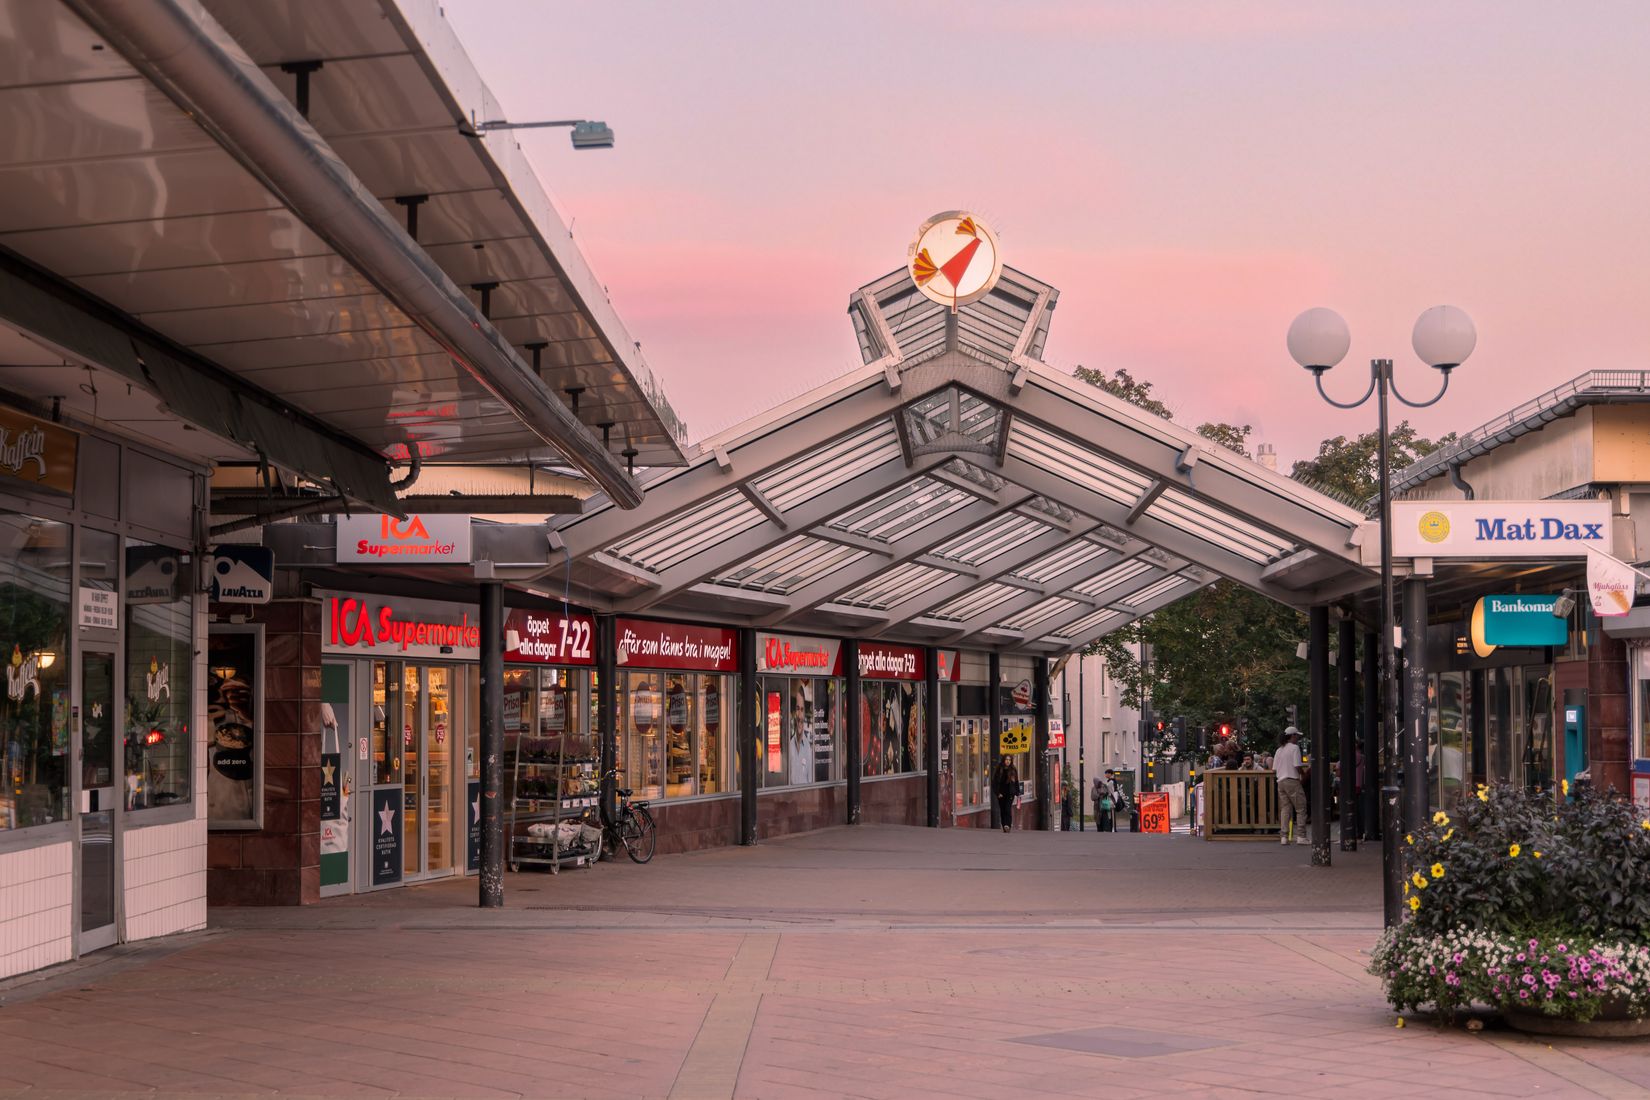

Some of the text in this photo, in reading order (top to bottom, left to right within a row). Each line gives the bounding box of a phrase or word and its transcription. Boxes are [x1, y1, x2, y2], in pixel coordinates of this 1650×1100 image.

[381, 513, 431, 540] ICA
[1475, 518, 1536, 541] Mat
[1540, 518, 1604, 540] Dax
[356, 539, 455, 557] Supermarket
[221, 585, 264, 598] LAVAZZA
[1491, 599, 1556, 613] Bankoma
[330, 596, 376, 647] ICA
[527, 615, 550, 637] öppet
[519, 637, 557, 661] alla dagar
[558, 619, 591, 659] 7-22
[618, 628, 732, 668] affär som känns bra i magen!
[765, 636, 829, 671] ICA Supermarket
[875, 650, 887, 671] alla
[886, 651, 904, 677] dagar
[904, 653, 916, 673] 7-22
[1143, 813, 1158, 830] 69
